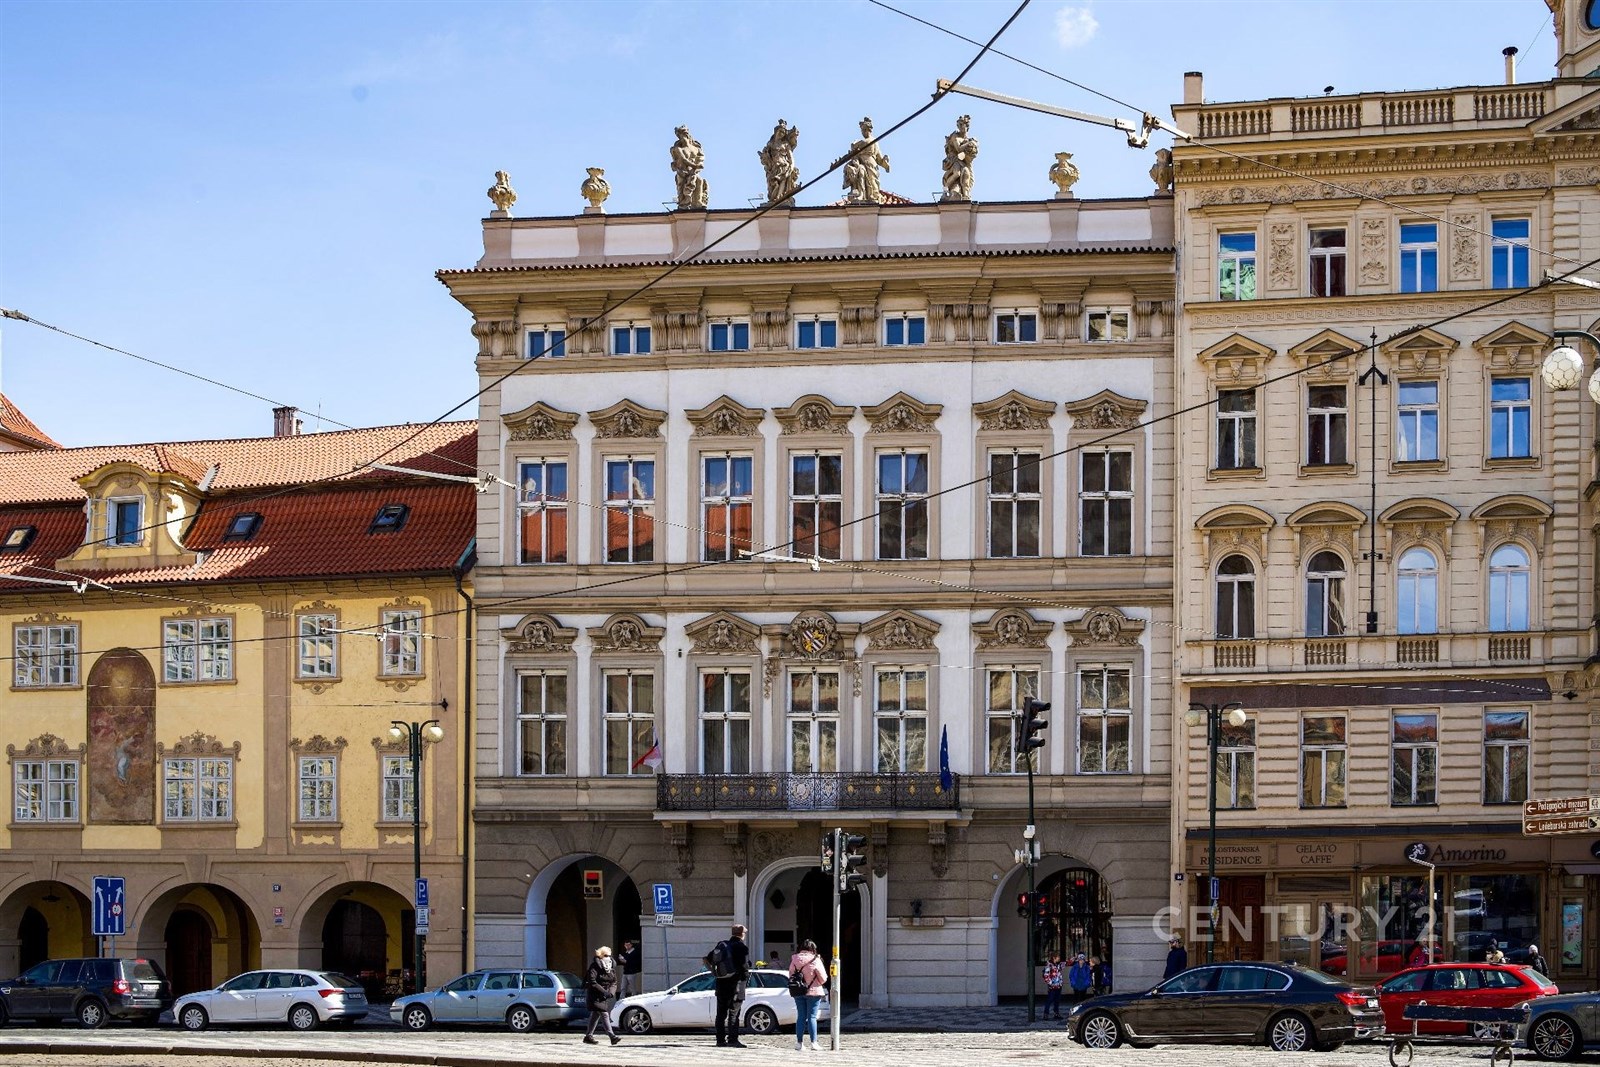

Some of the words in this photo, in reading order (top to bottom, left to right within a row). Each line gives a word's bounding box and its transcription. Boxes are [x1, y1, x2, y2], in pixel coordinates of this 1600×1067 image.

[1203, 845, 1260, 853] MLOSTRANSKÁ
[1295, 843, 1337, 853] GELATO
[1430, 844, 1506, 861] Amorino
[657, 887, 668, 904] P
